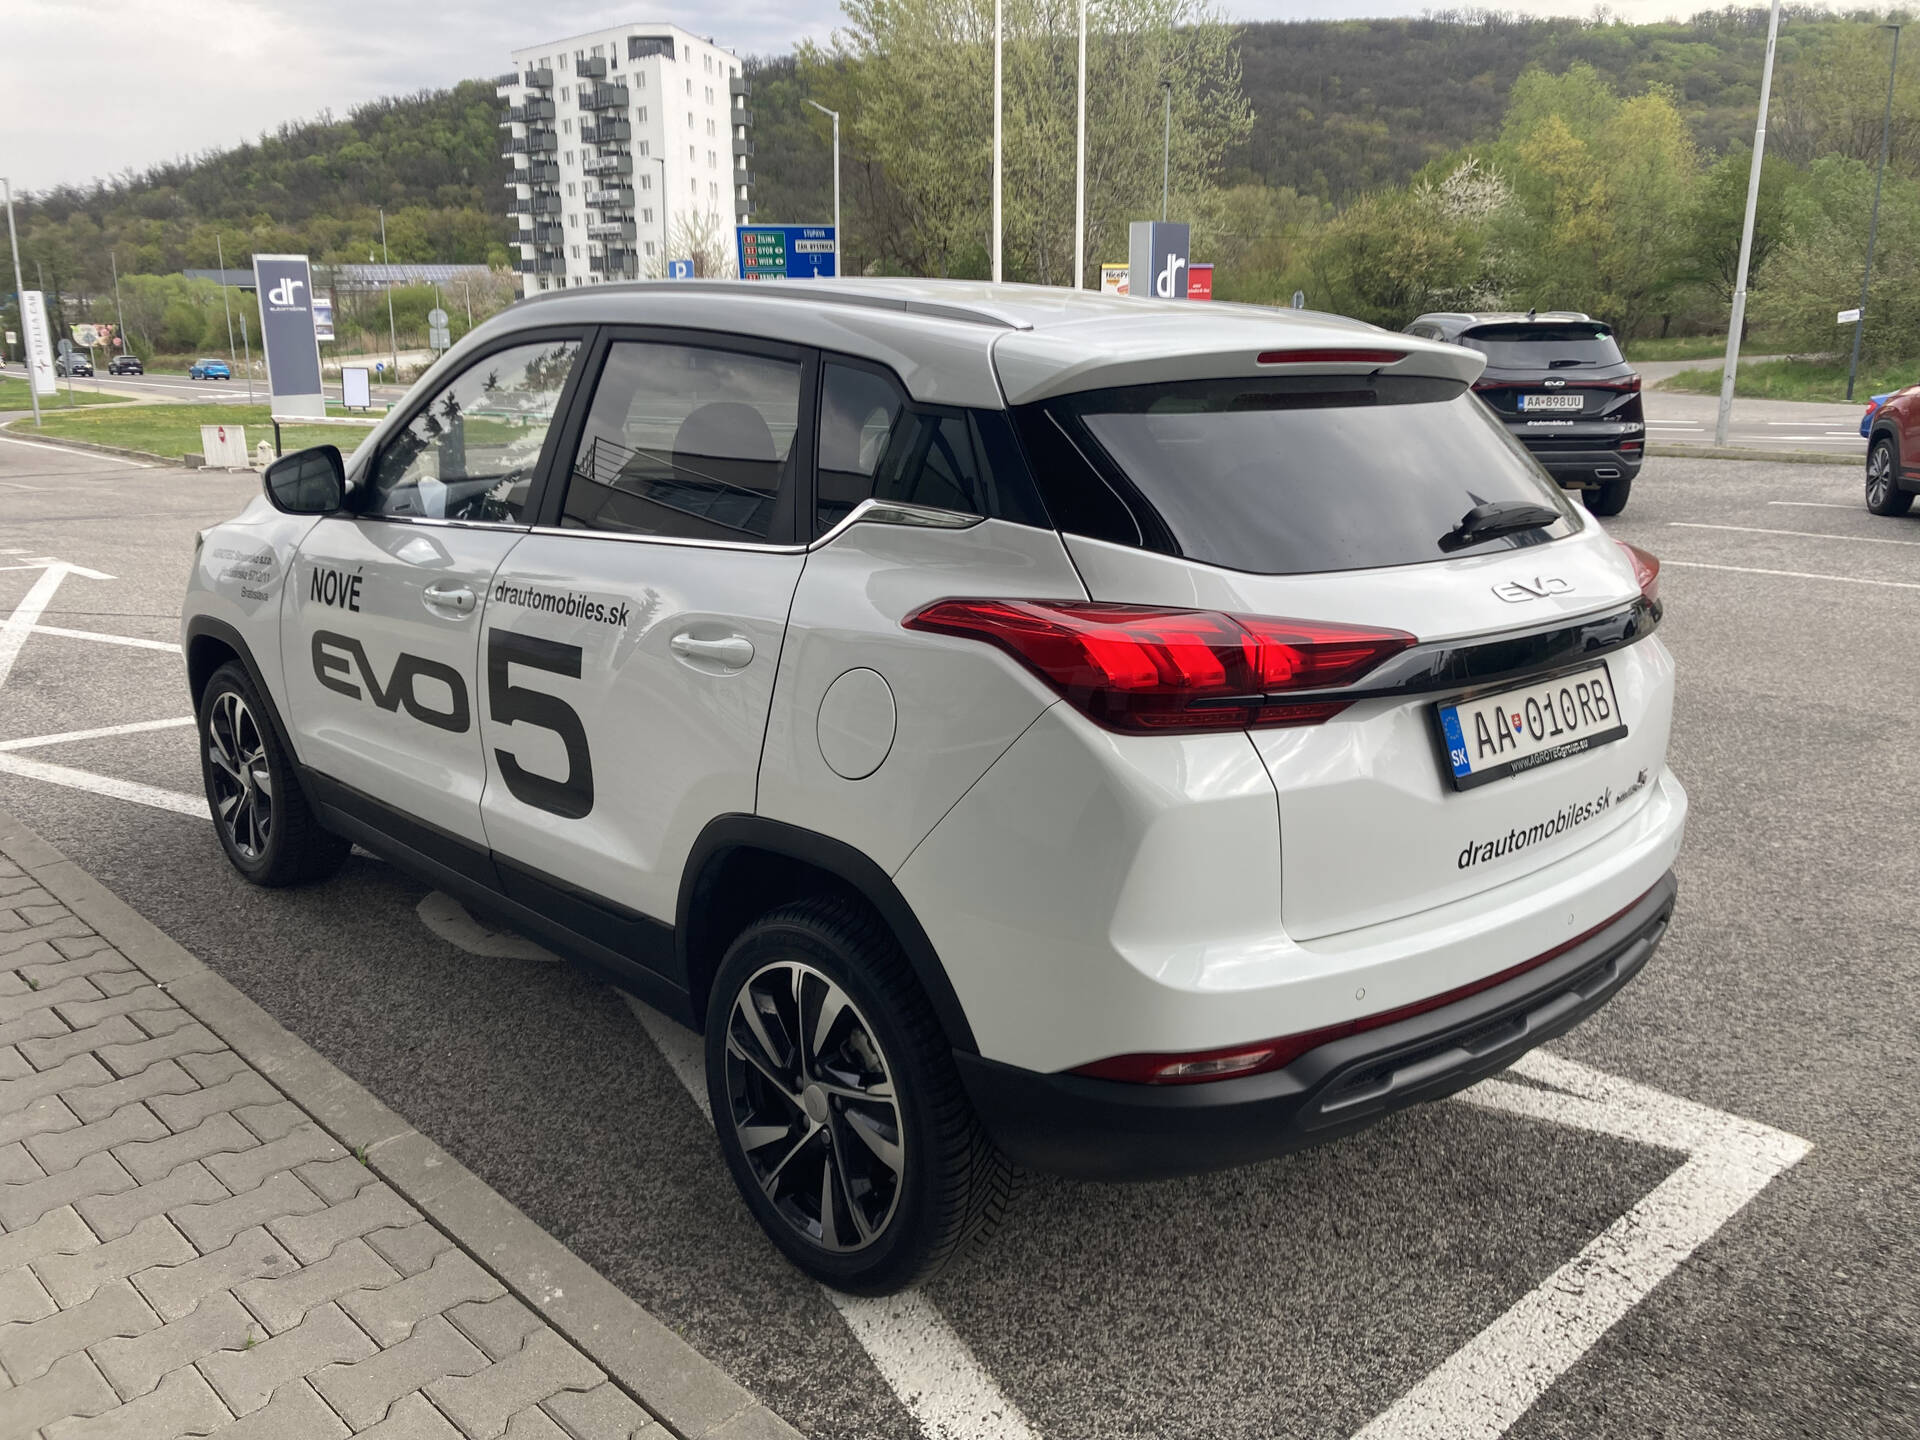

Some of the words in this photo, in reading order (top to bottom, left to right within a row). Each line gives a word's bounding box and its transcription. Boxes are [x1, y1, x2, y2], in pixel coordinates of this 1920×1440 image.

[268, 278, 303, 305] dr
[675, 262, 687, 280] P
[1156, 253, 1186, 298] dr
[311, 566, 363, 613] NOVÉ
[494, 580, 631, 627] drautomobiles.sk
[1491, 577, 1576, 603] EVO
[311, 629, 471, 734] EVO
[488, 627, 595, 820] 5
[1451, 748, 1468, 767] SK
[1457, 787, 1612, 869] drautomobiles.sk
